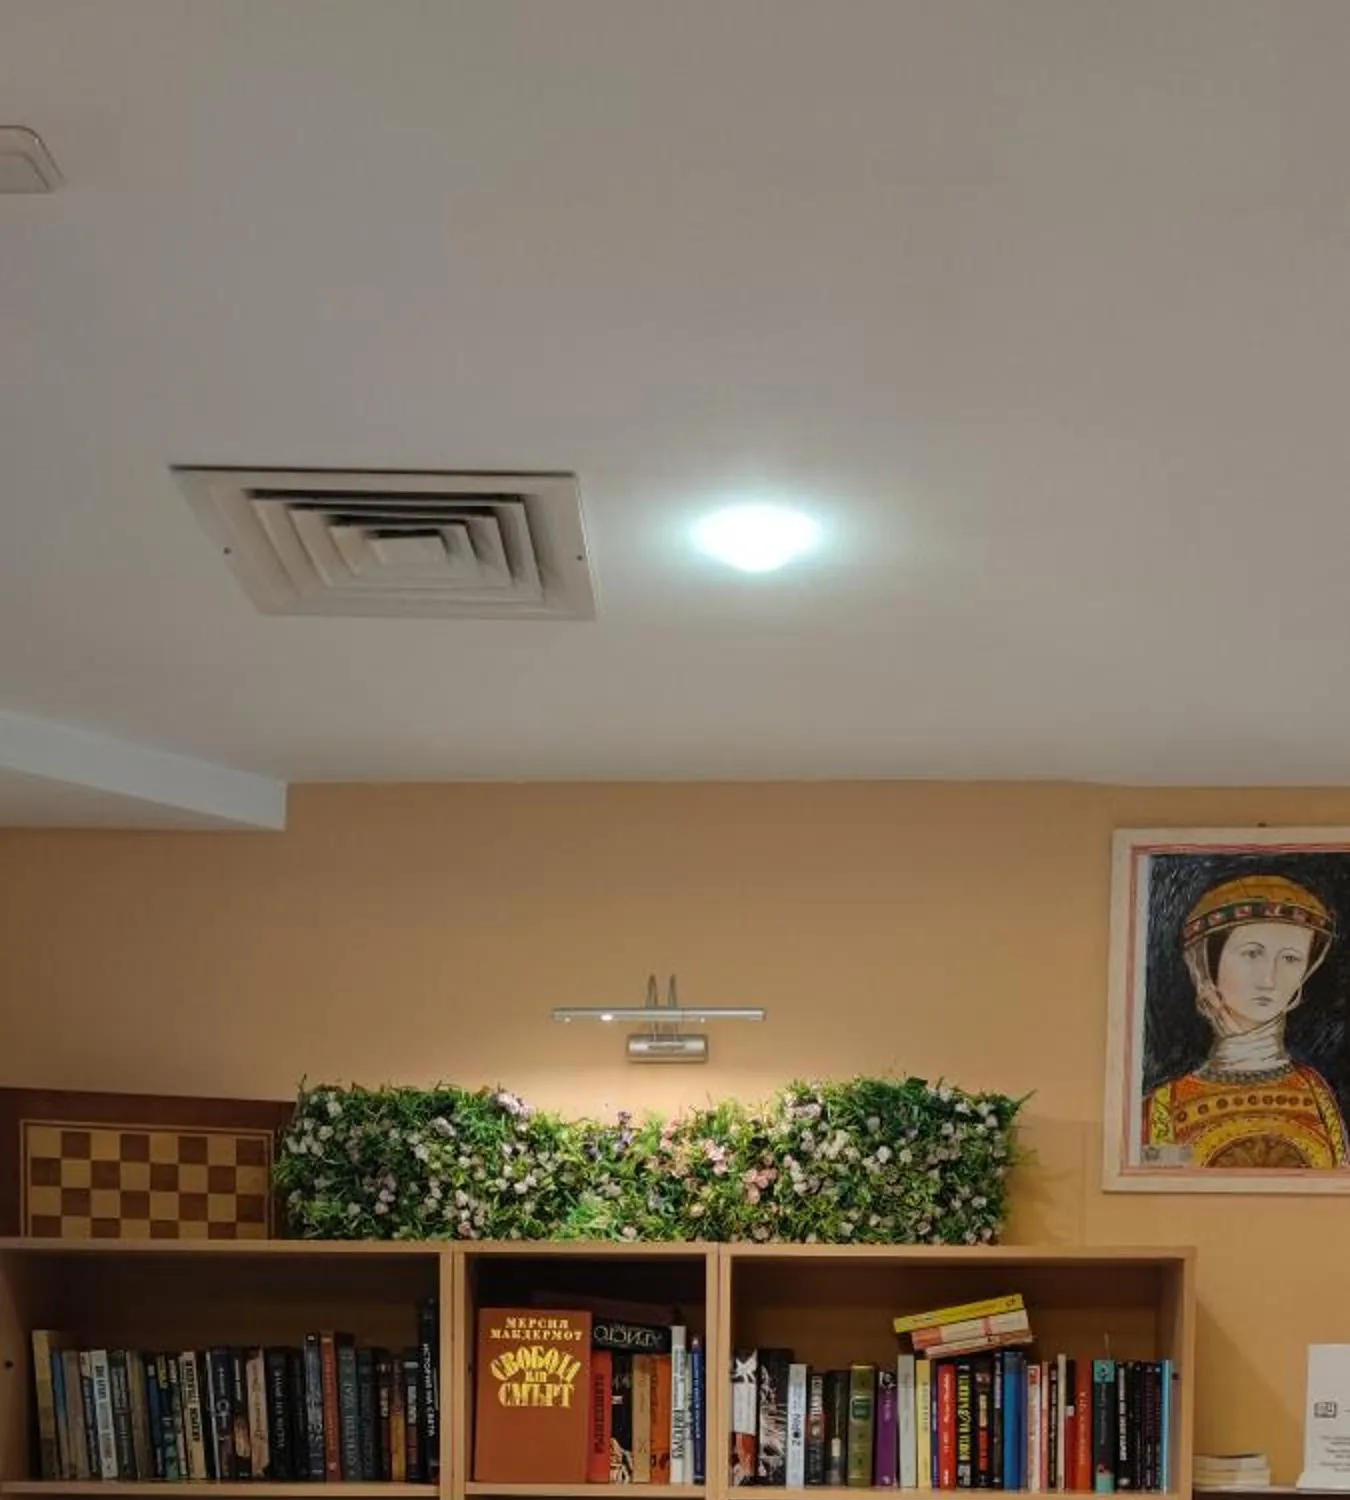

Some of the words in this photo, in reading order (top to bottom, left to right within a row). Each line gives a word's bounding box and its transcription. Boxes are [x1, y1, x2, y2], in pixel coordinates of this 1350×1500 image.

[505, 1316, 569, 1329] МЕРСИЯ
[490, 1328, 583, 1341] МАКДЕРМОТ
[490, 1344, 583, 1382] СВОБОДА
[498, 1382, 575, 1410] СМЪРТ
